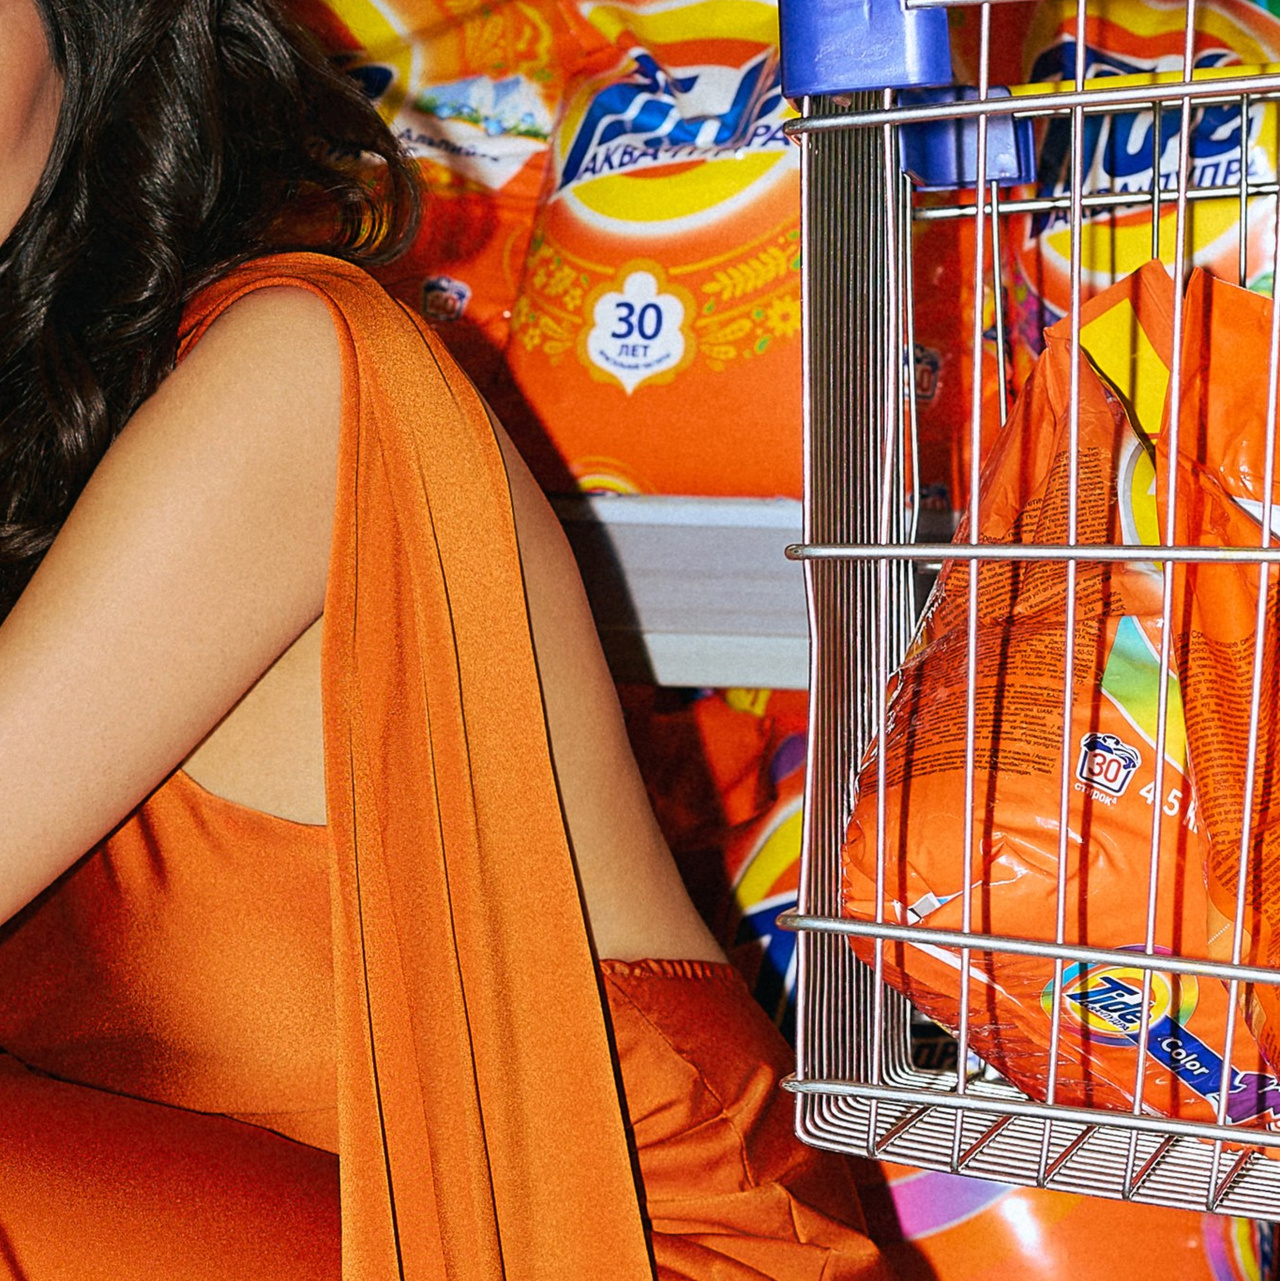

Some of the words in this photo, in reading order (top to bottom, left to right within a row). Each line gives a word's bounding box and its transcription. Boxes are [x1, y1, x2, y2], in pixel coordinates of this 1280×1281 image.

[611, 302, 662, 340] 30
[618, 344, 650, 358] ЛЕТ
[1091, 752, 1121, 783] 30
[1138, 781, 1184, 817] 45
[1161, 1038, 1209, 1077] Color
